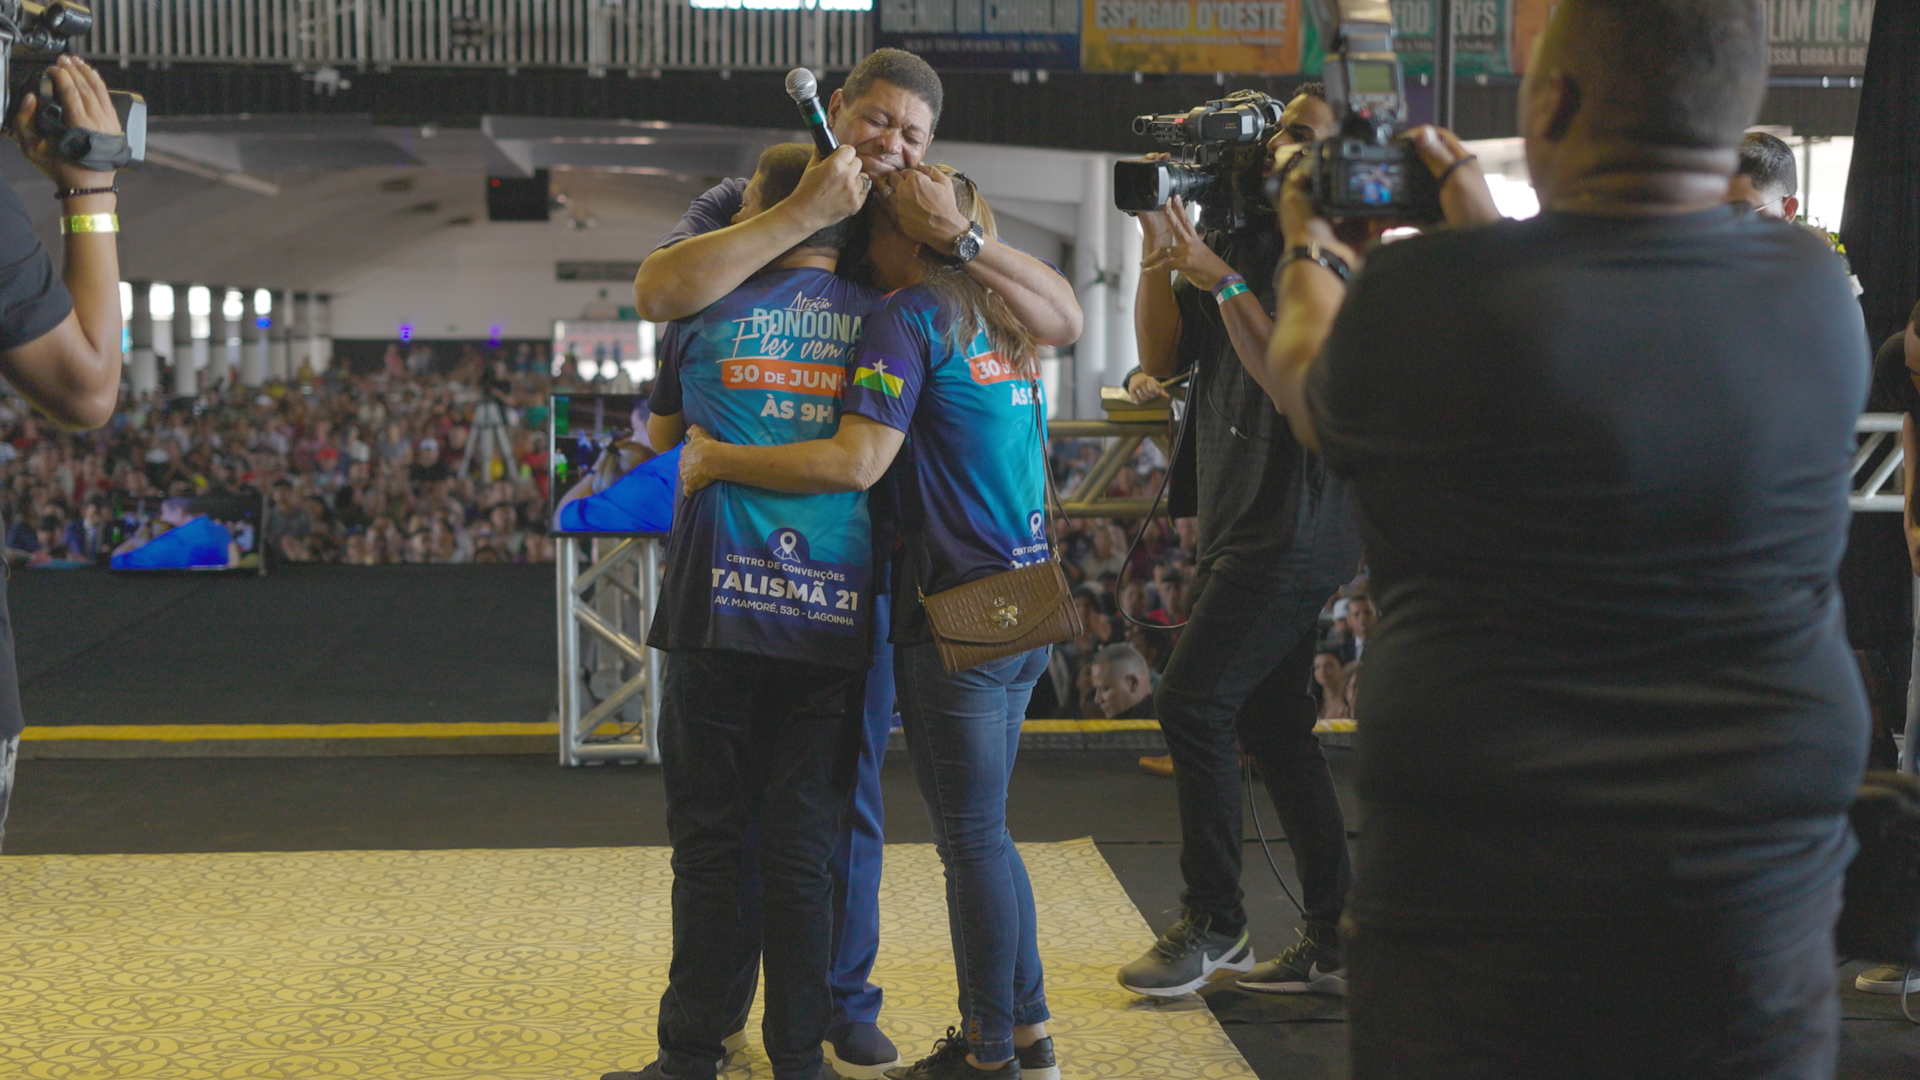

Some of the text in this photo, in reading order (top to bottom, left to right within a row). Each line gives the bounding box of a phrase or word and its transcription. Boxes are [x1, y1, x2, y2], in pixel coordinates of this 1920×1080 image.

[1196, 0, 1286, 31] D'OESTE
[800, 338, 844, 361] vem
[729, 365, 760, 384] 30
[764, 371, 786, 386] DE
[976, 359, 1001, 380] 30
[1010, 383, 1028, 406] ÀS
[760, 394, 834, 424] ÀS 9H
[726, 554, 845, 582] CENTRO DE CONVENÇÕES
[711, 568, 859, 612] TALISMÃ 21
[714, 595, 731, 607] AV.
[731, 597, 779, 614] MAMORÉ,
[779, 605, 800, 618] 530
[807, 610, 854, 627] LAGOINHA
